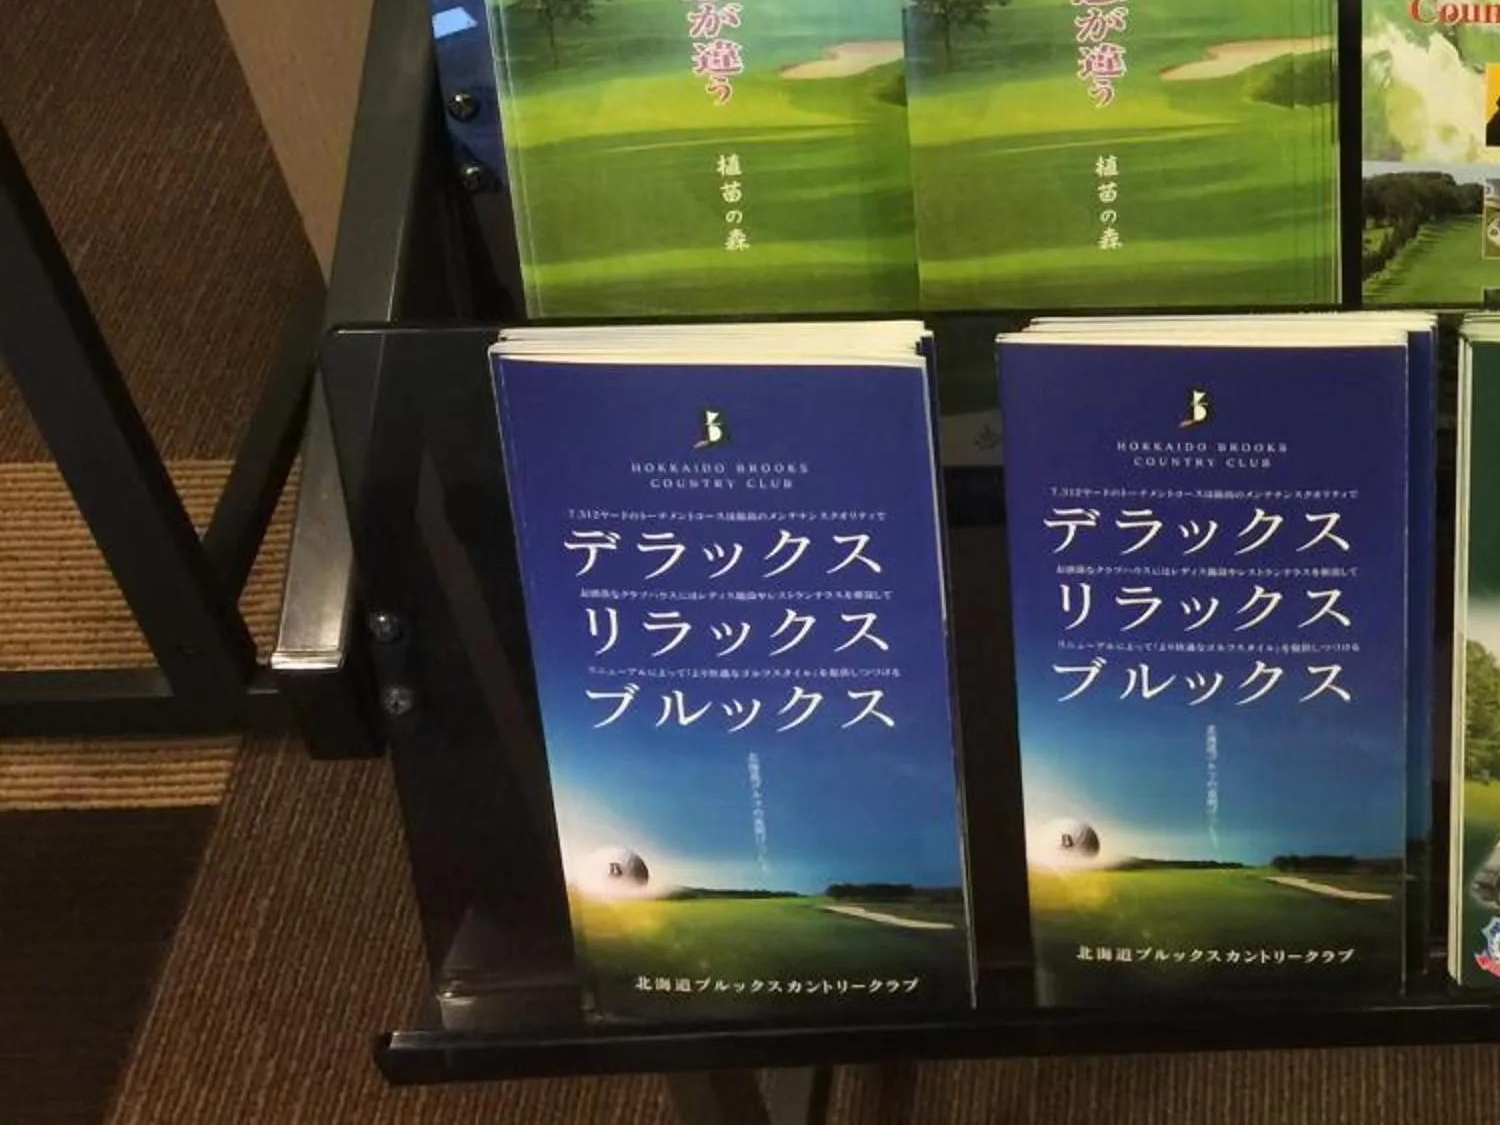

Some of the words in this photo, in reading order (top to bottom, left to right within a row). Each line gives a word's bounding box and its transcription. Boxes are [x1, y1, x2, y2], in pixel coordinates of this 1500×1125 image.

[716, 153, 750, 252] 植苗の森
[1096, 155, 1123, 251] 植苗の森
[631, 462, 726, 474] HOKKAIDO
[736, 462, 809, 474] BROOKS
[1117, 441, 1208, 453] HOKKAIDO
[1217, 441, 1288, 453] BROOKS
[1133, 457, 1216, 468] COUNTRY
[1226, 457, 1272, 468] CLUB
[650, 478, 736, 490] COUNTRY
[746, 478, 794, 490] CLUB
[563, 529, 882, 580] デラックス
[1043, 508, 1351, 556] デラックス
[1060, 582, 1351, 633] リラックス
[585, 607, 890, 658] リラックス
[1052, 656, 1351, 706] ブルックス
[585, 683, 896, 733] ブルックス
[1076, 945, 1355, 964] 北海道ブルックスカントリークラブ
[635, 976, 919, 994] 北海道ブルックスカントリークラブ
